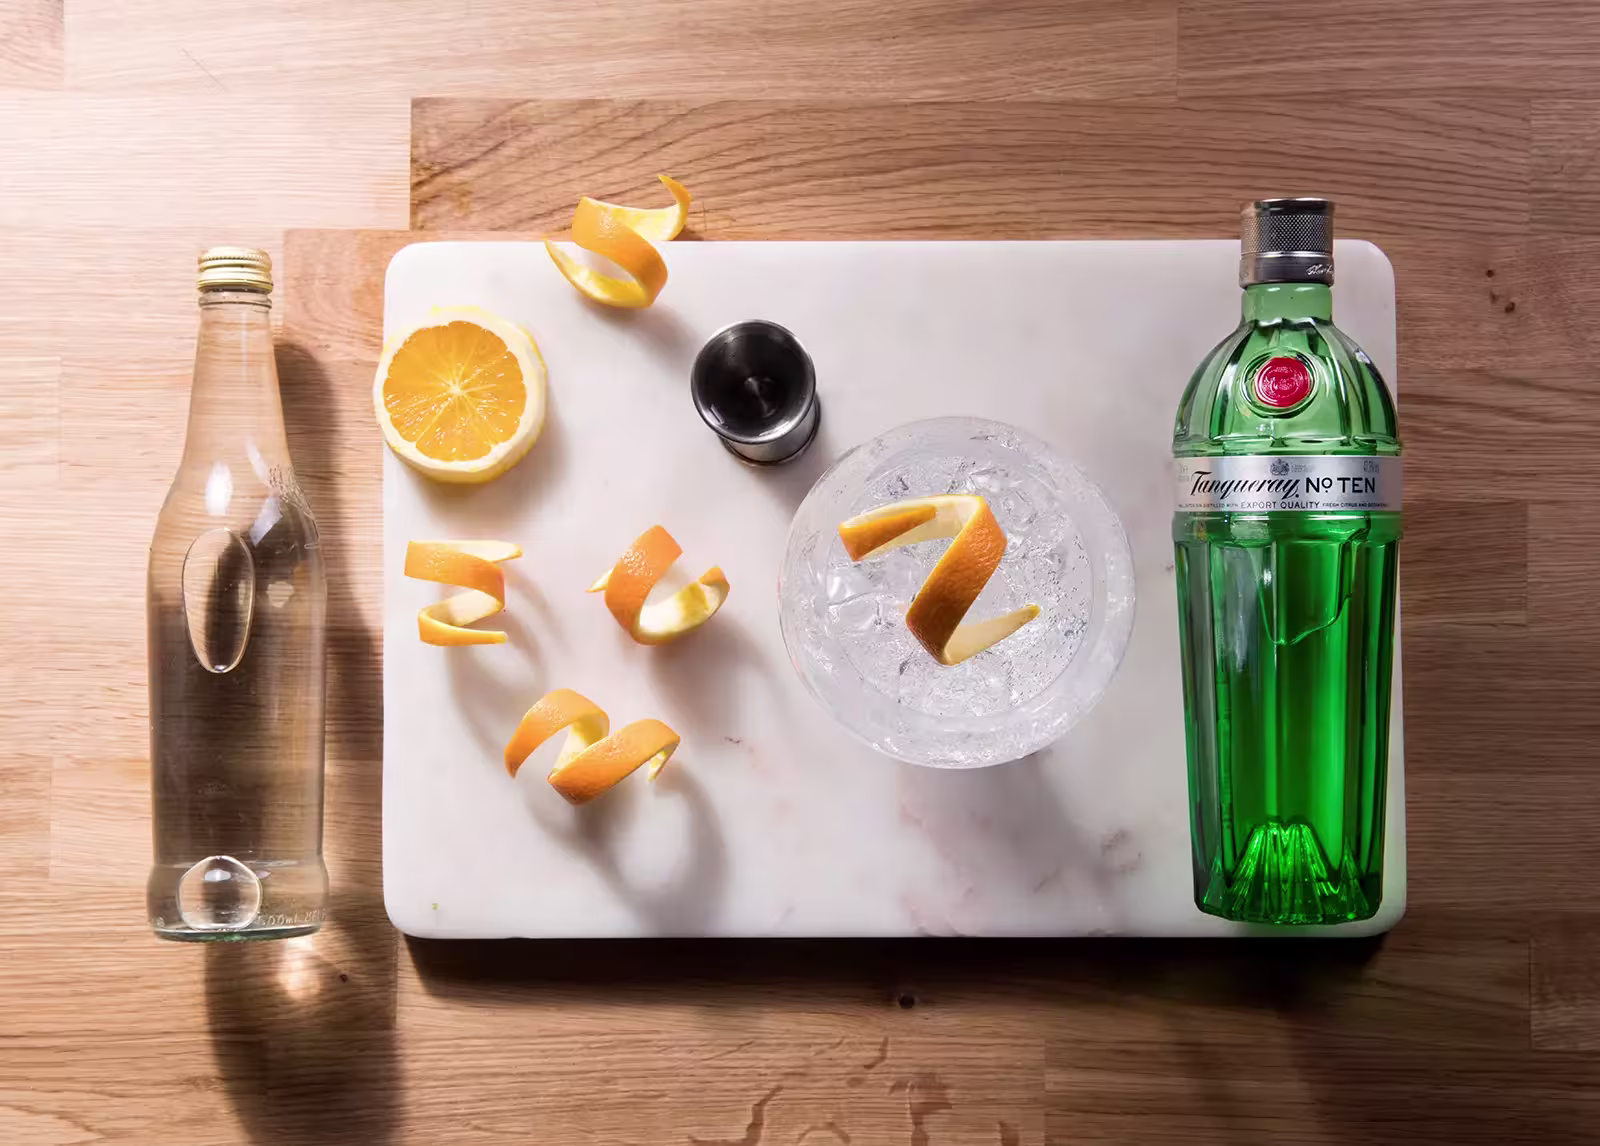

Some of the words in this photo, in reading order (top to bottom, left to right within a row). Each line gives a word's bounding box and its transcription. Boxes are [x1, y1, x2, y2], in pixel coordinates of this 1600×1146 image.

[1336, 477, 1376, 493] TEN
[1240, 501, 1277, 509] EXPORT
[1279, 501, 1320, 510] QUALITY
